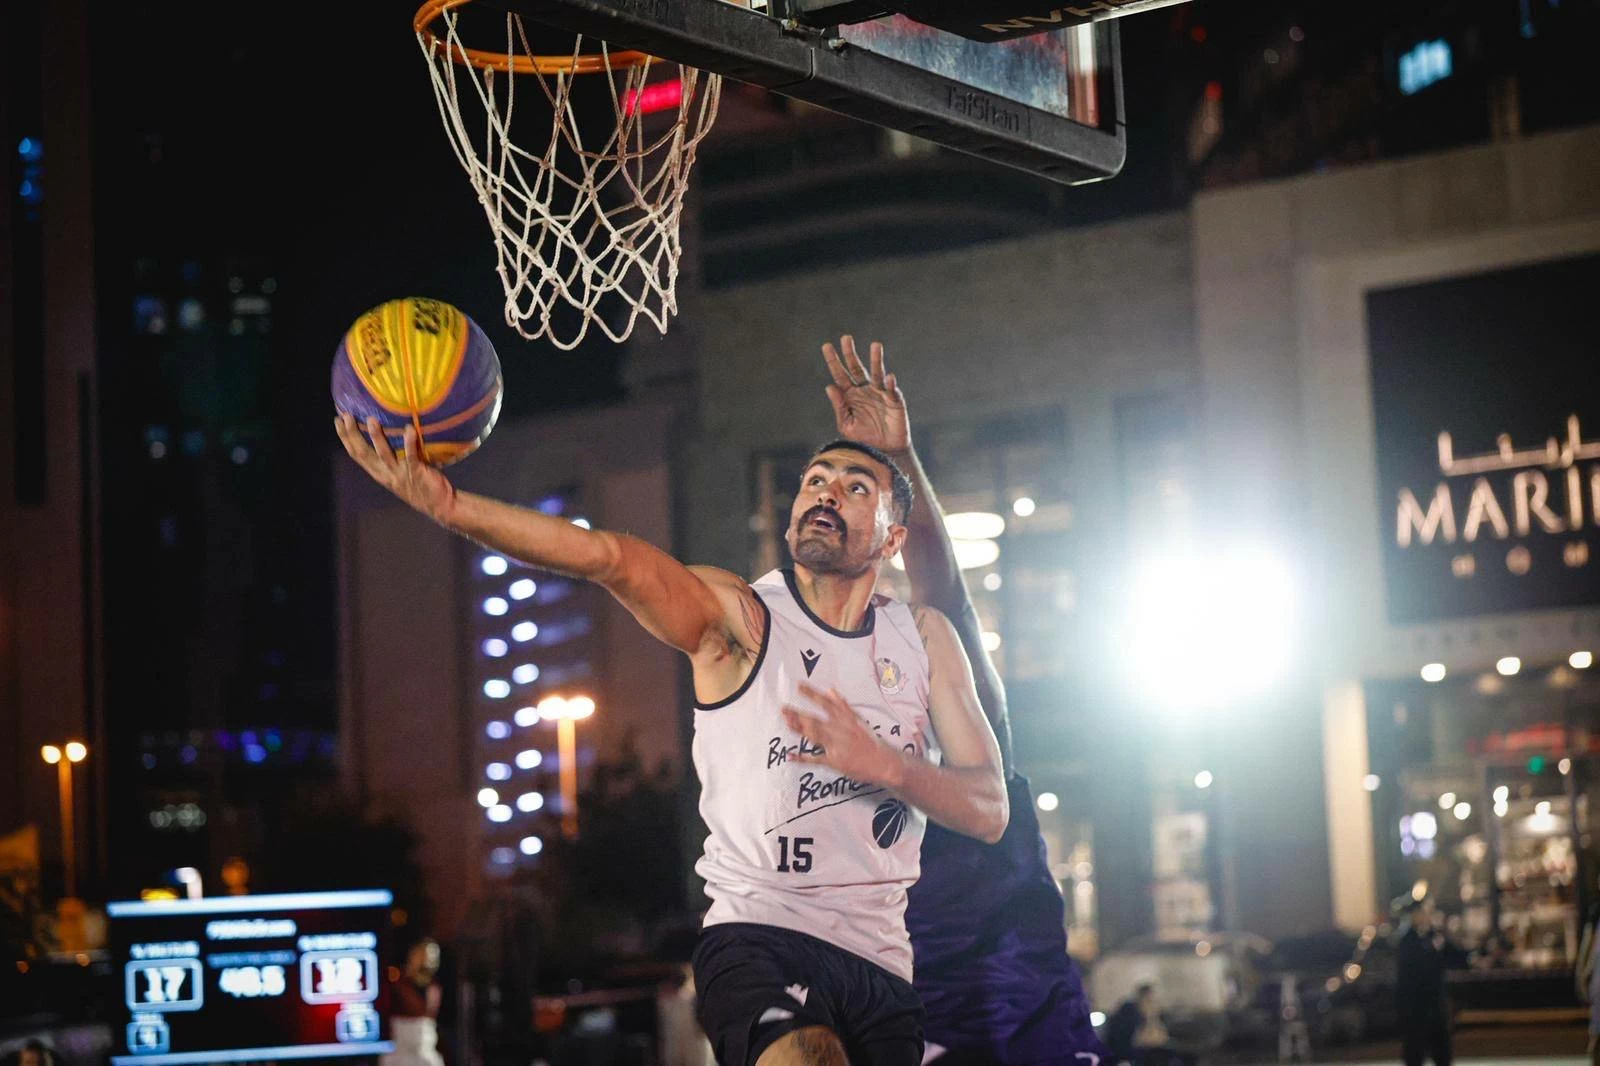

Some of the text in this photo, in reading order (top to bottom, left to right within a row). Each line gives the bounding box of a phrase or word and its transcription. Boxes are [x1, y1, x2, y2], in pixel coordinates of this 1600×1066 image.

[1397, 465, 1600, 549] MARI
[777, 836, 815, 873] 15
[144, 966, 186, 1002] 17
